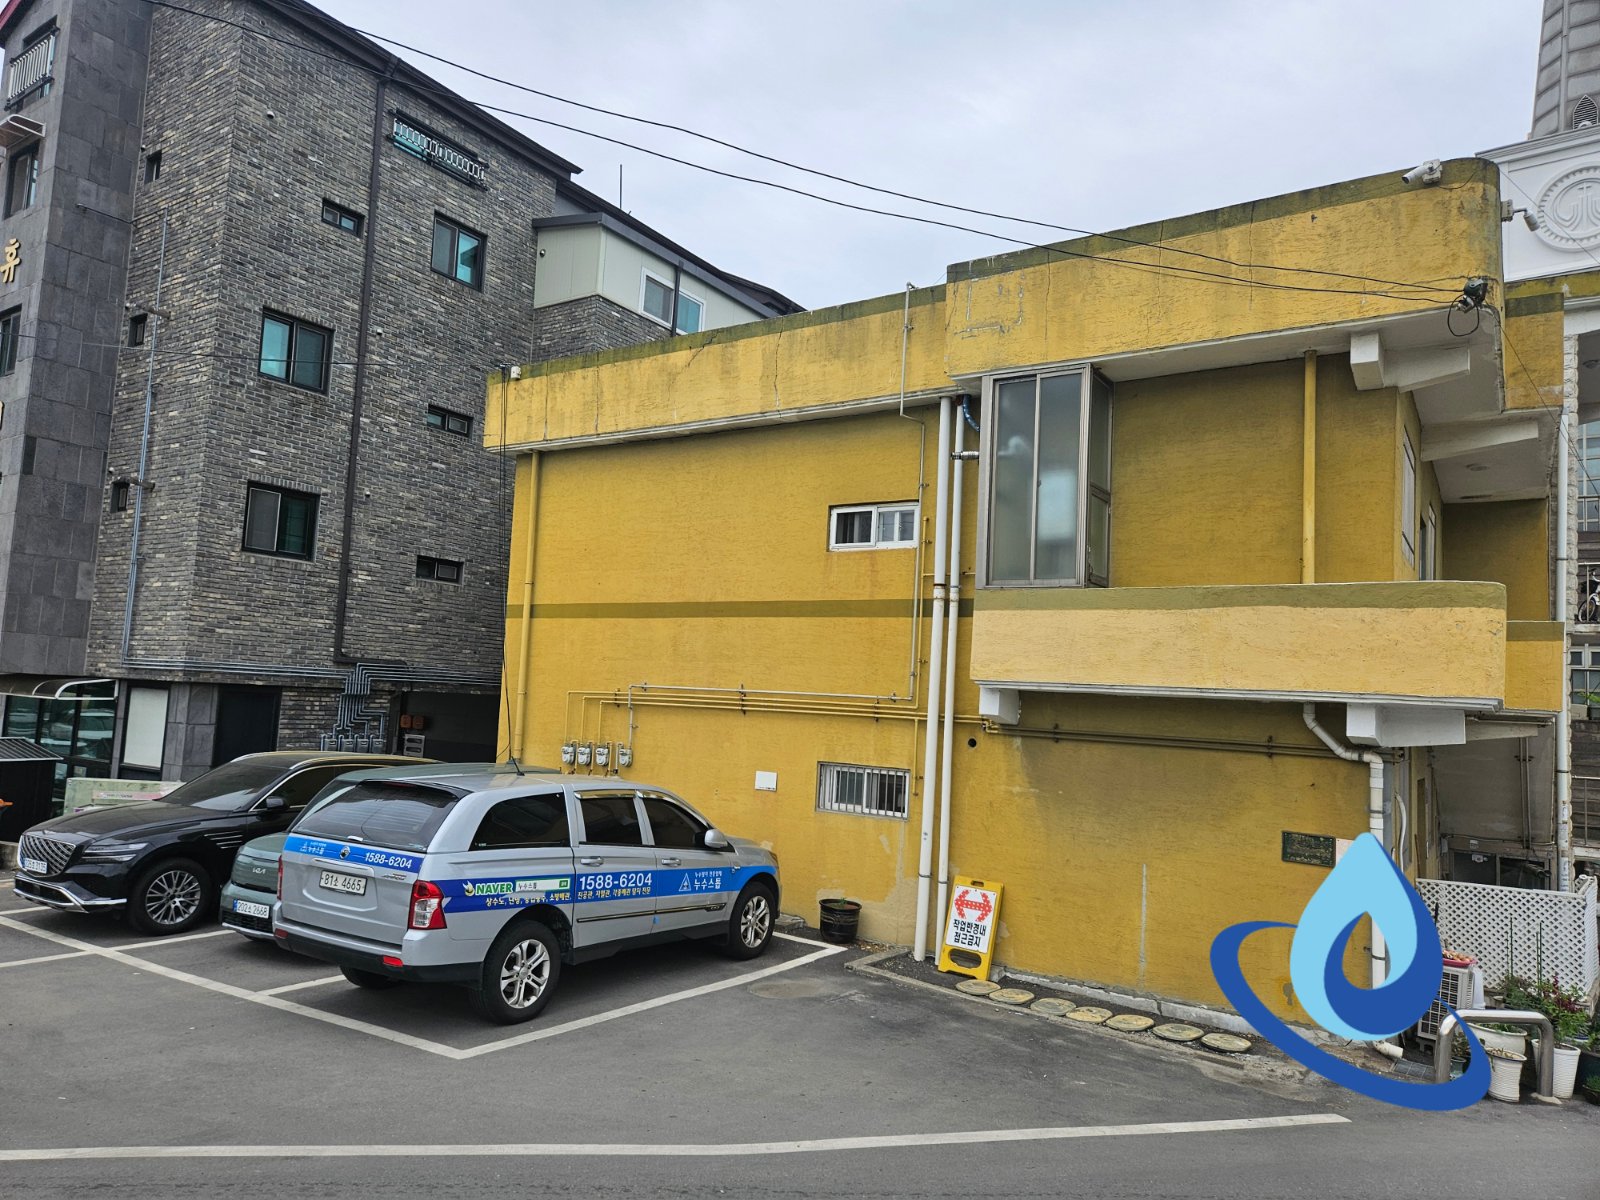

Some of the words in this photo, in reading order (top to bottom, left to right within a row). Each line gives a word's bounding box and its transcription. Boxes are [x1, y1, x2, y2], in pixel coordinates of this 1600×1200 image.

[365, 852, 412, 869] 1588-6204
[341, 876, 361, 892] 4665
[475, 882, 513, 895] NAVER
[579, 873, 652, 890] 1588-6204
[693, 877, 722, 891] 누수스톱
[953, 919, 986, 936] 작업반경내
[954, 932, 981, 947] 접근금지
